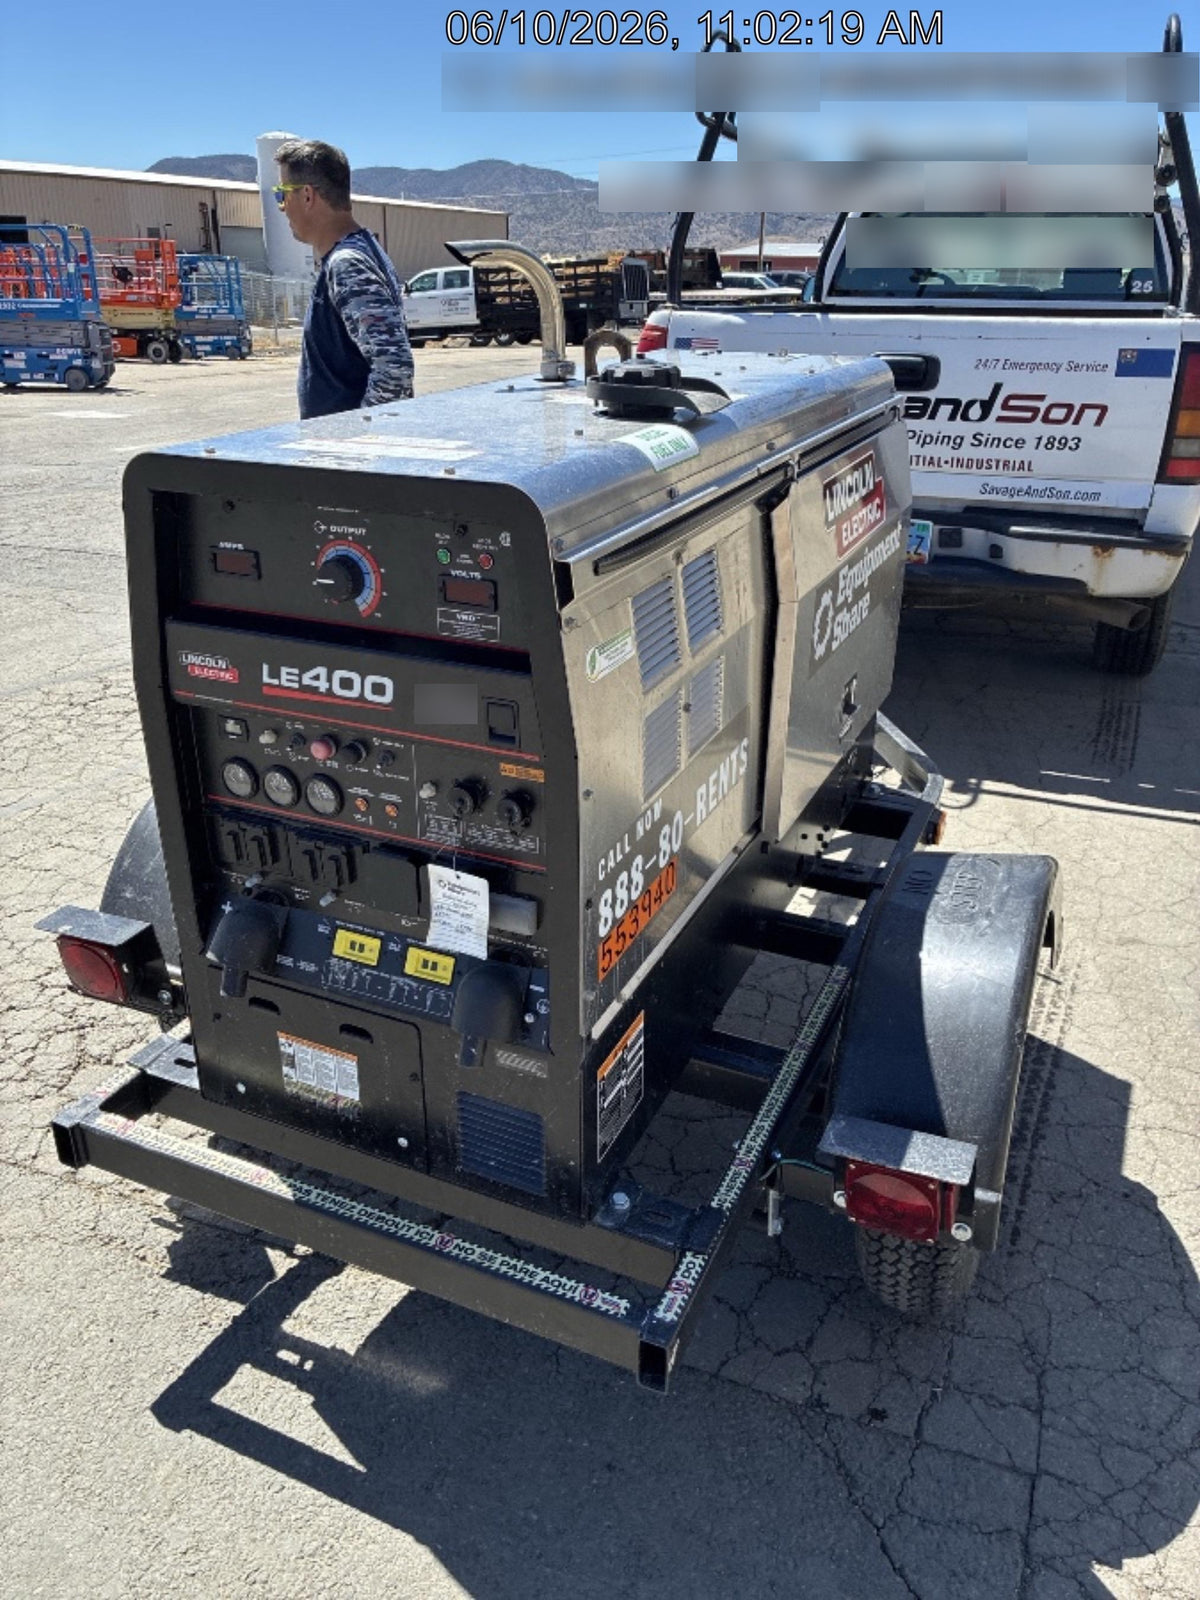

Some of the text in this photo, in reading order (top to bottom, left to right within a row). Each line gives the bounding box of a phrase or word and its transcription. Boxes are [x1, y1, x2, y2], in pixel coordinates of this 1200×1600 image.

[974, 358, 1108, 373] 24/7 Emergency Service
[907, 429, 1082, 451] Piping Since 1893
[826, 461, 875, 522] LINCOLN
[979, 482, 1102, 502] SavageAndSon.com
[330, 525, 367, 536] OUTPUT
[841, 499, 881, 547] ELECTRIC
[450, 569, 482, 580] VOLTS
[836, 520, 903, 606] Equipment
[832, 591, 871, 651] Share
[181, 653, 227, 669] LINCOLN
[262, 662, 394, 704] LE400
[598, 737, 750, 938] 888-80-RENTS
[598, 798, 663, 882] CALL NOW
[600, 860, 676, 974] 553940
[313, 1191, 357, 1214] TENEZ
[355, 1207, 413, 1234] DEBOUT
[413, 1227, 435, 1242] ICI
[451, 1241, 476, 1257] NO
[476, 1249, 498, 1265] SE
[498, 1257, 540, 1280] PARE
[677, 1259, 698, 1279] DO
